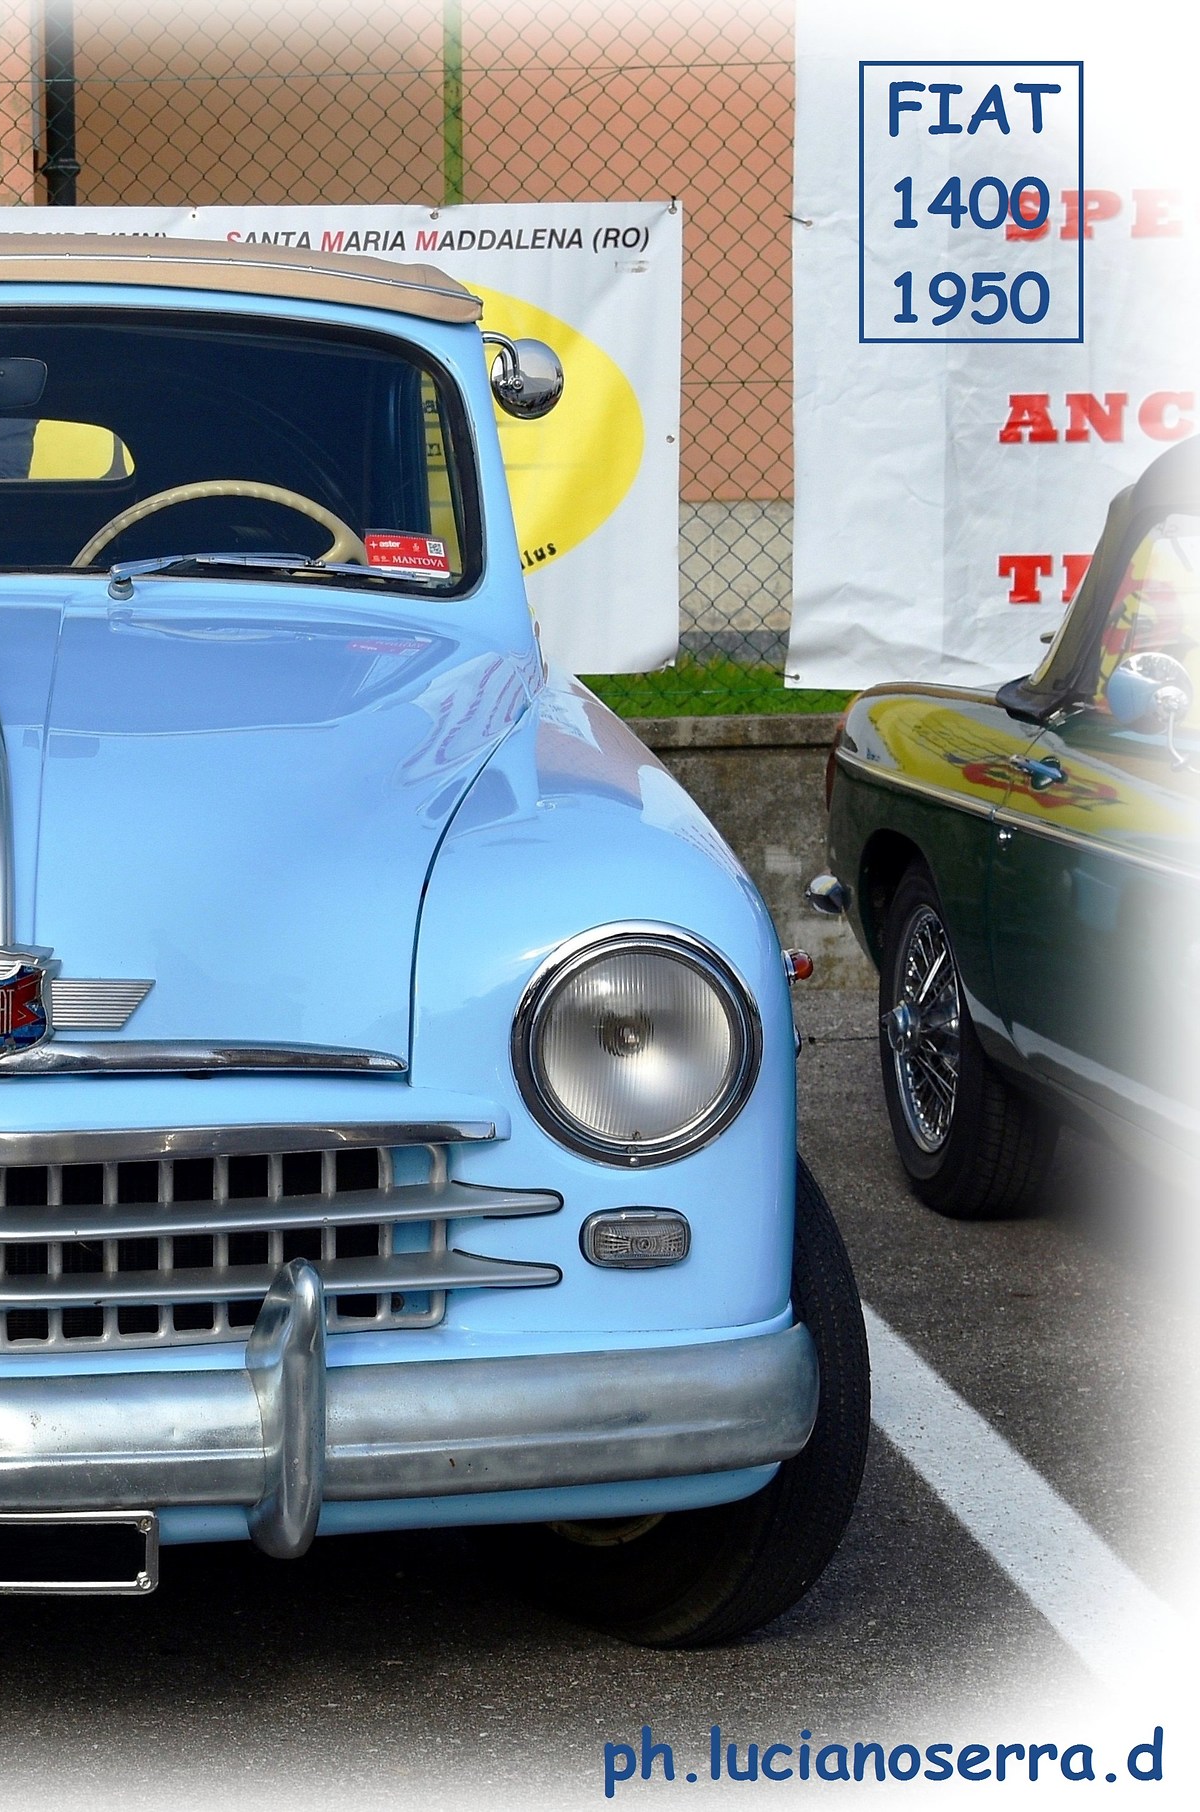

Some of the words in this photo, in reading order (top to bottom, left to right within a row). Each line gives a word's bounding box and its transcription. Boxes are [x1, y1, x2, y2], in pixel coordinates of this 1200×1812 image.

[321, 230, 406, 252] MARIA
[415, 228, 584, 251] MADDALENA
[592, 226, 650, 253] (RO)
[392, 555, 445, 568] MANTOVA
[520, 542, 557, 570] lus
